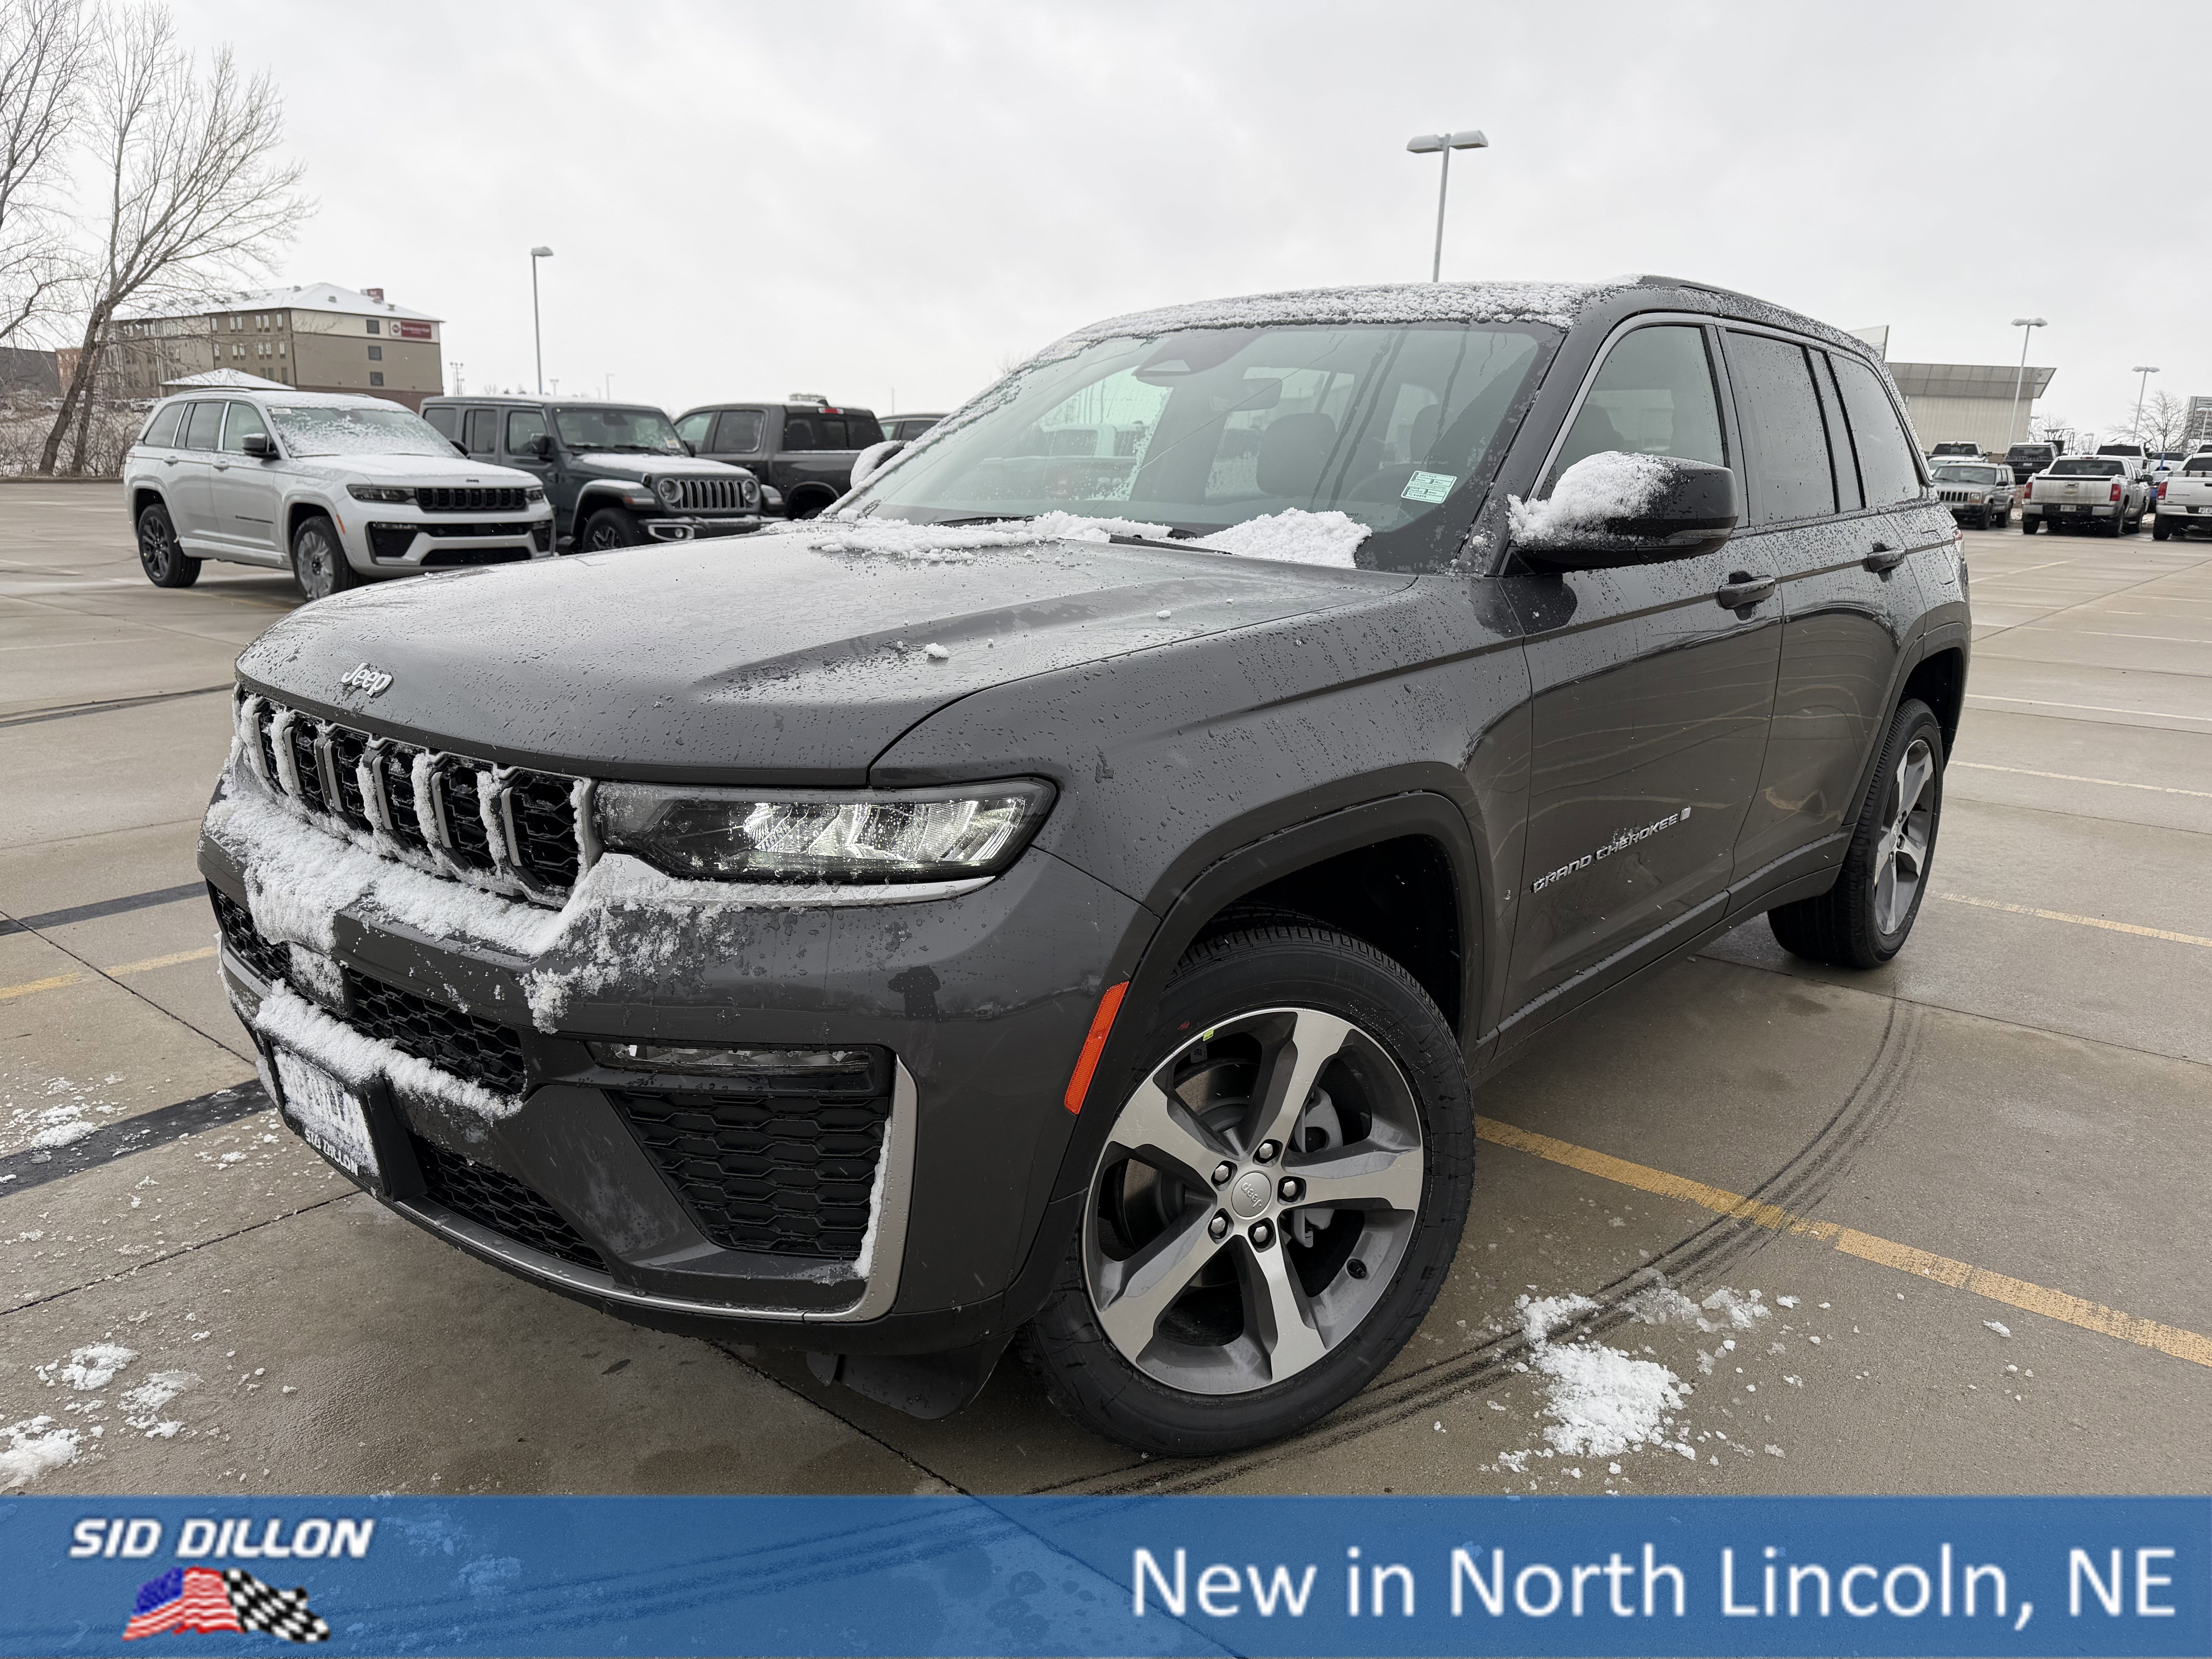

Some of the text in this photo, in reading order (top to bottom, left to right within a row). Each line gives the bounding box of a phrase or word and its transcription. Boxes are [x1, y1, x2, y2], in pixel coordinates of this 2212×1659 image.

[341, 663, 393, 697] Jeep
[1532, 813, 1678, 893] GRAND CHEROKEE
[323, 1139, 359, 1176] DILLON
[1241, 1182, 1262, 1207] Jeep
